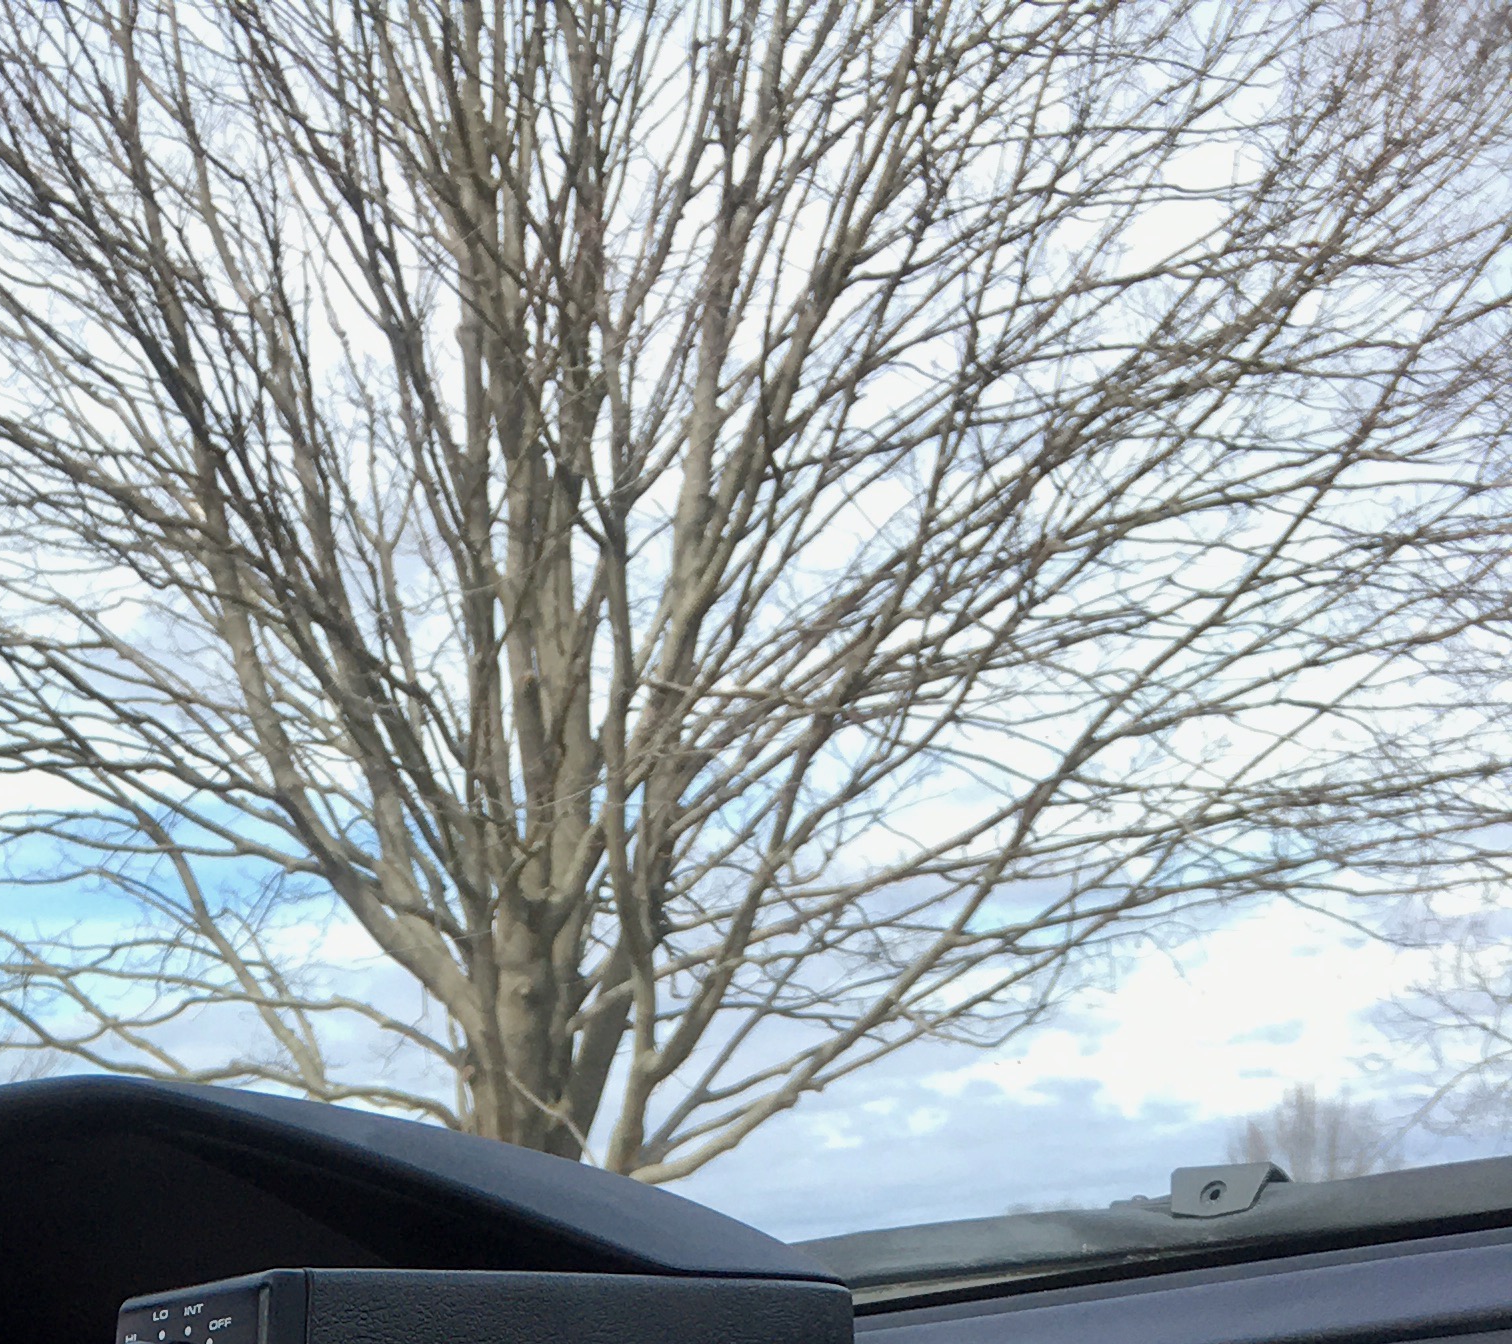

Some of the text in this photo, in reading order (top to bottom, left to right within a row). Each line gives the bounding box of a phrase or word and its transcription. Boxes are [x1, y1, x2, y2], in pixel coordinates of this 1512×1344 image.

[152, 1309, 169, 1322] LO
[184, 1303, 204, 1316] INT
[208, 1317, 232, 1331] OFF
